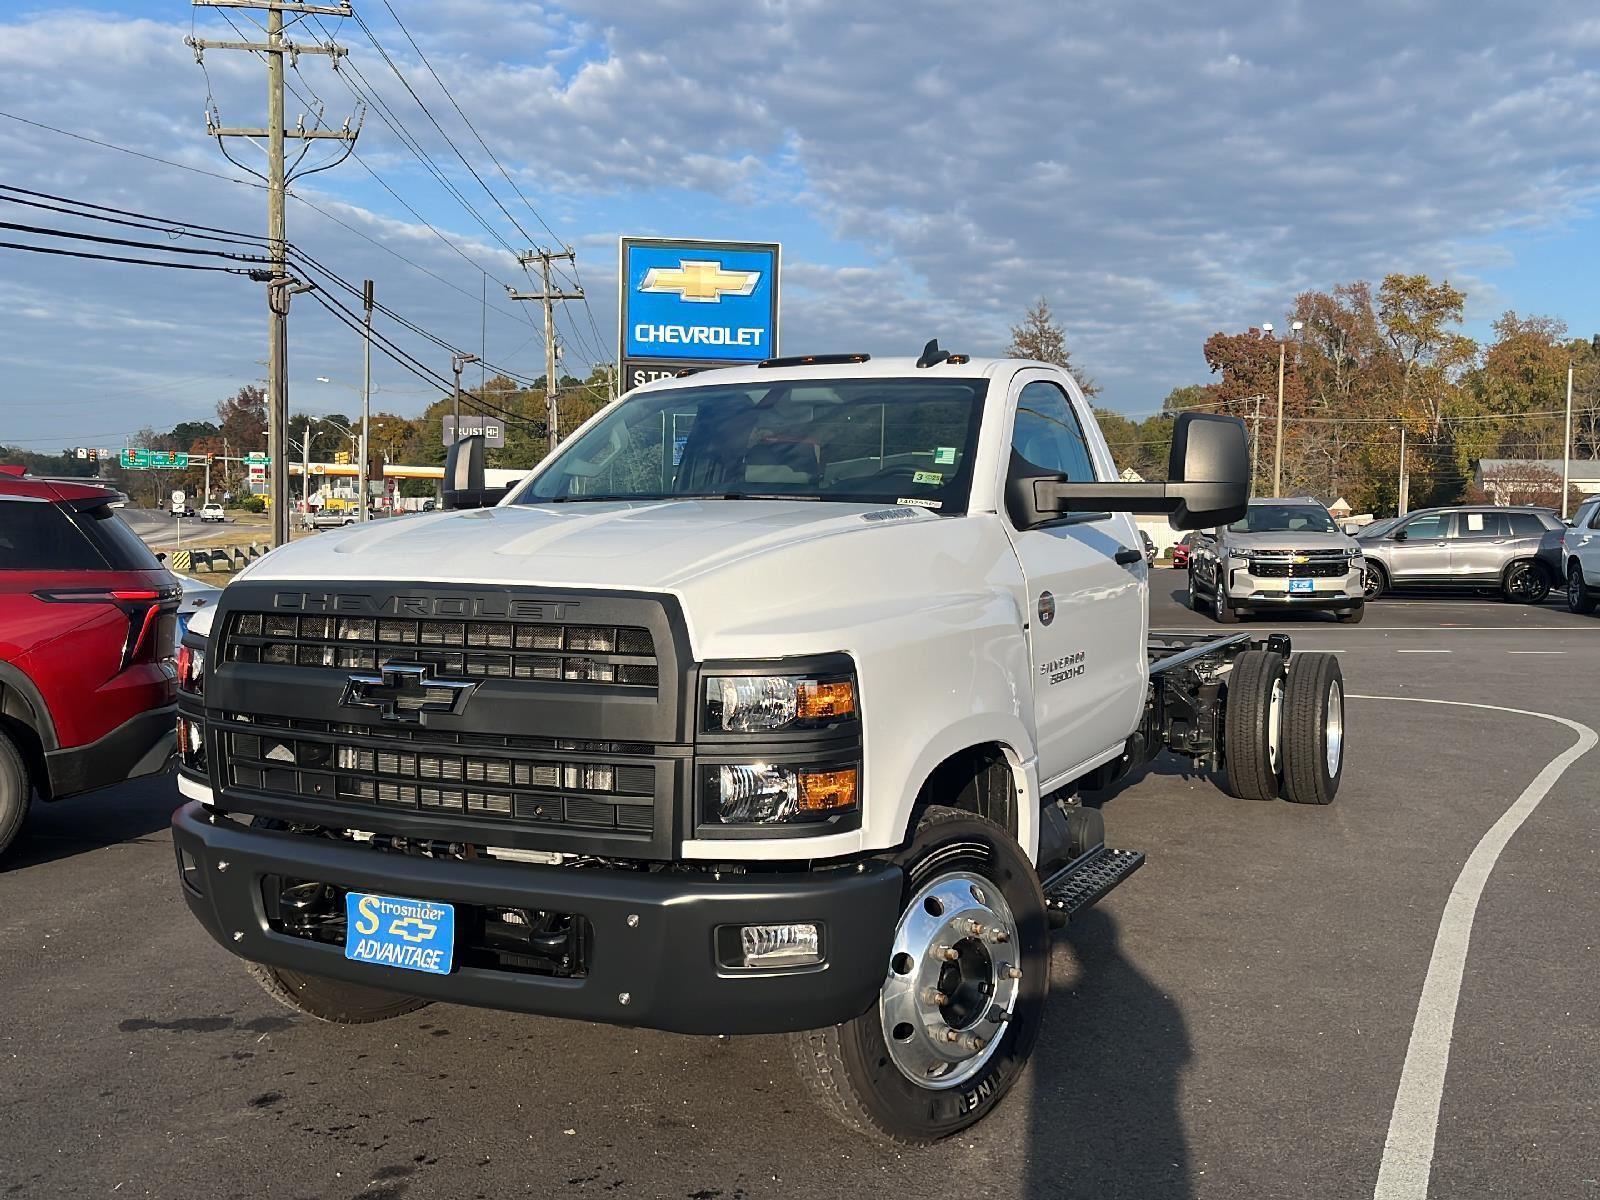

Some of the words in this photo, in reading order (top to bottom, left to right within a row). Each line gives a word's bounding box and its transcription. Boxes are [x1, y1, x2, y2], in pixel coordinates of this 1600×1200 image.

[634, 324, 765, 346] CHEVROLET
[273, 591, 581, 620] CHEVROLET
[355, 896, 445, 935] Strosnider
[353, 938, 445, 970] ADVANTAGE
